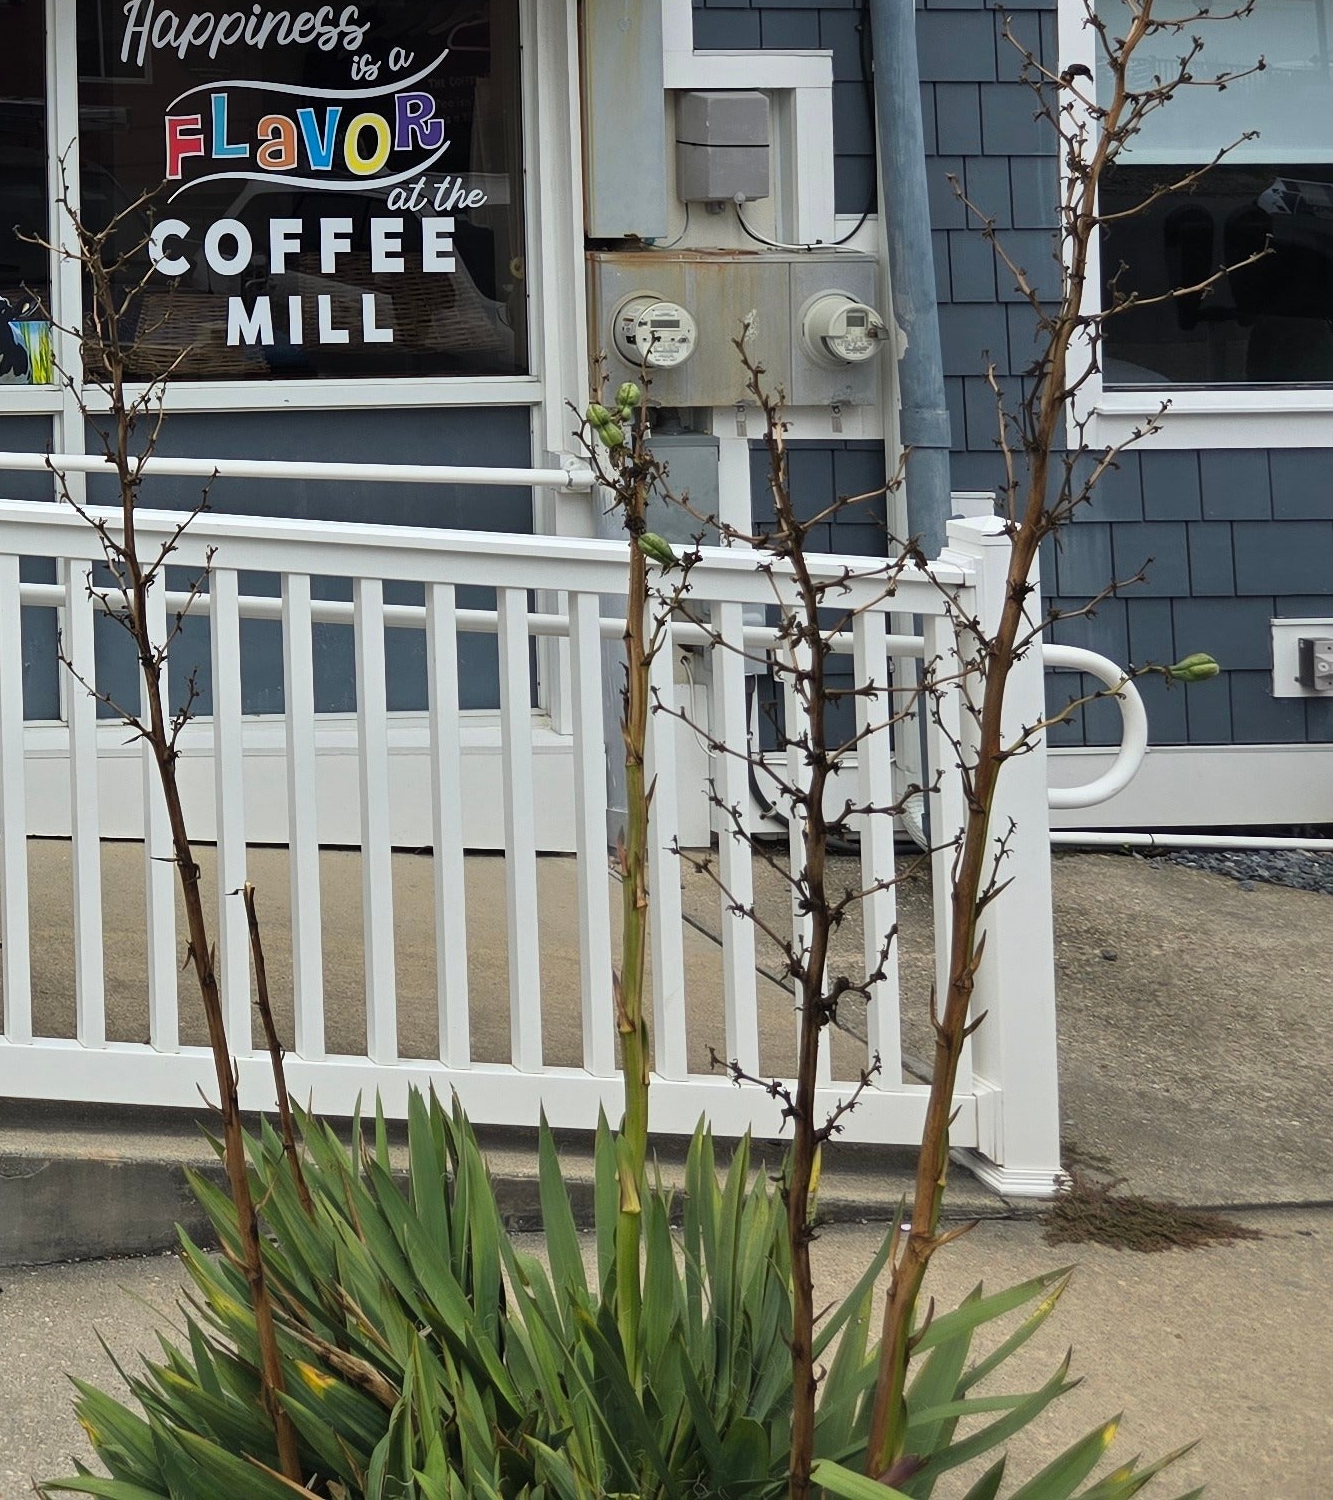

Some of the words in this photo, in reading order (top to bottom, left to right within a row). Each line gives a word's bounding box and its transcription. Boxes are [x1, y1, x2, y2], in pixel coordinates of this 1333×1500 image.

[351, 53, 381, 81] is
[389, 47, 415, 71] a
[387, 178, 428, 212] at
[433, 176, 488, 211] the
[148, 216, 456, 276] COFFEE
[226, 293, 394, 346] MILL
